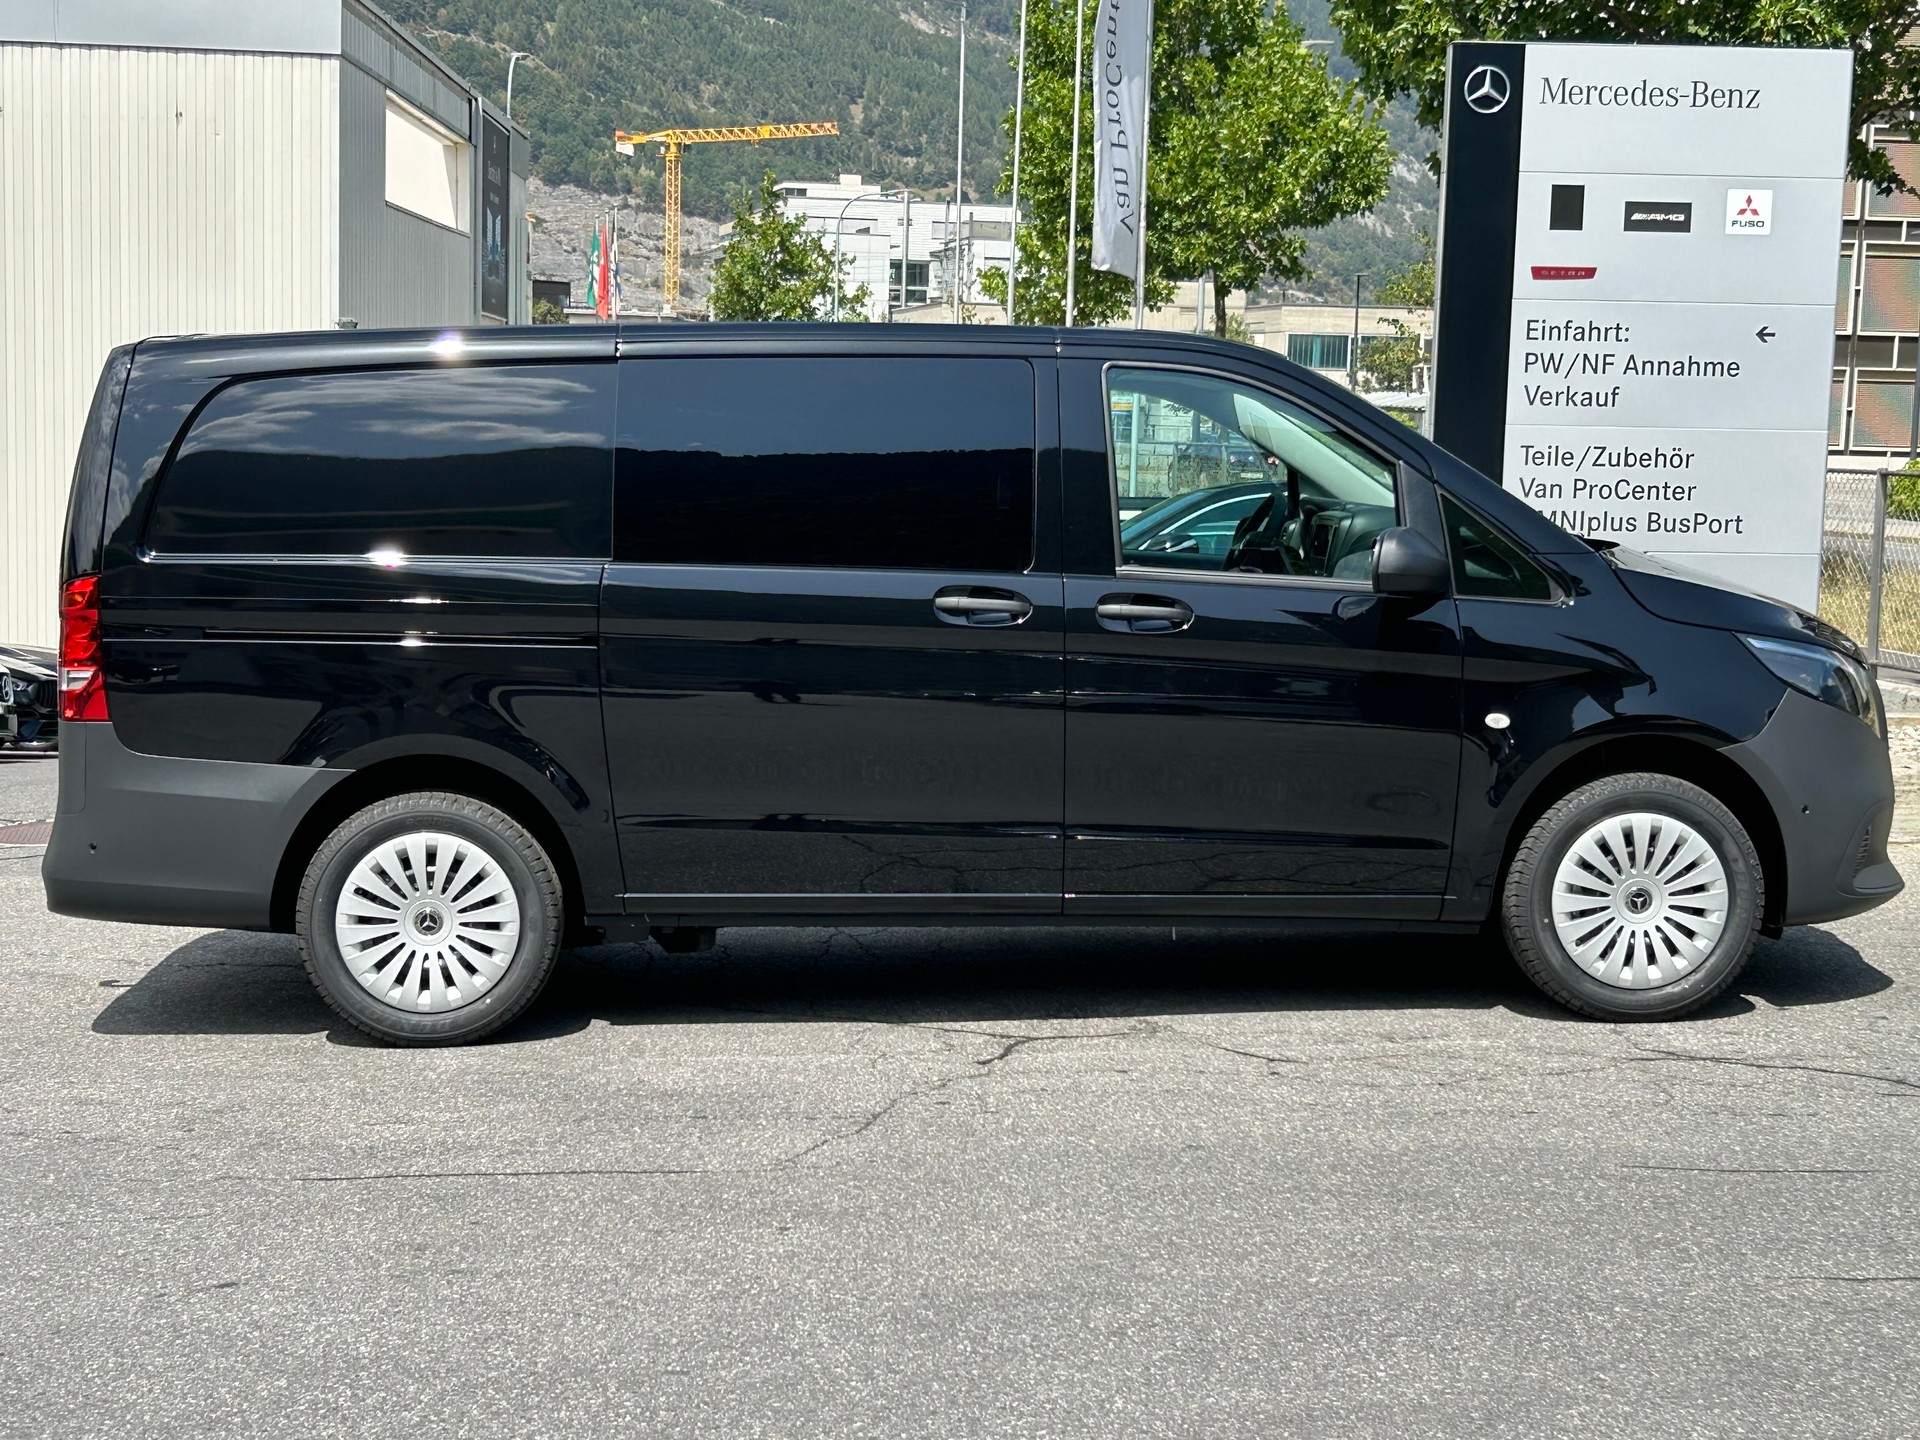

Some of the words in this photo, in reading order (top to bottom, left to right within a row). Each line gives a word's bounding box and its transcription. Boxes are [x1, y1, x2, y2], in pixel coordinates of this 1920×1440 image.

[1539, 77, 1761, 109] Mercedes-Benz
[1731, 219, 1766, 229] FUSO
[1526, 319, 1631, 342] Einfahrt:
[1524, 352, 1617, 379] PW/NF
[1622, 354, 1741, 378] Annahme
[1524, 385, 1620, 408] Verkauf
[1520, 445, 1695, 472] Teile/Zubehör
[1519, 477, 1563, 499] Van
[1572, 479, 1697, 501] ProCenter
[1646, 512, 1744, 534] BusPort
